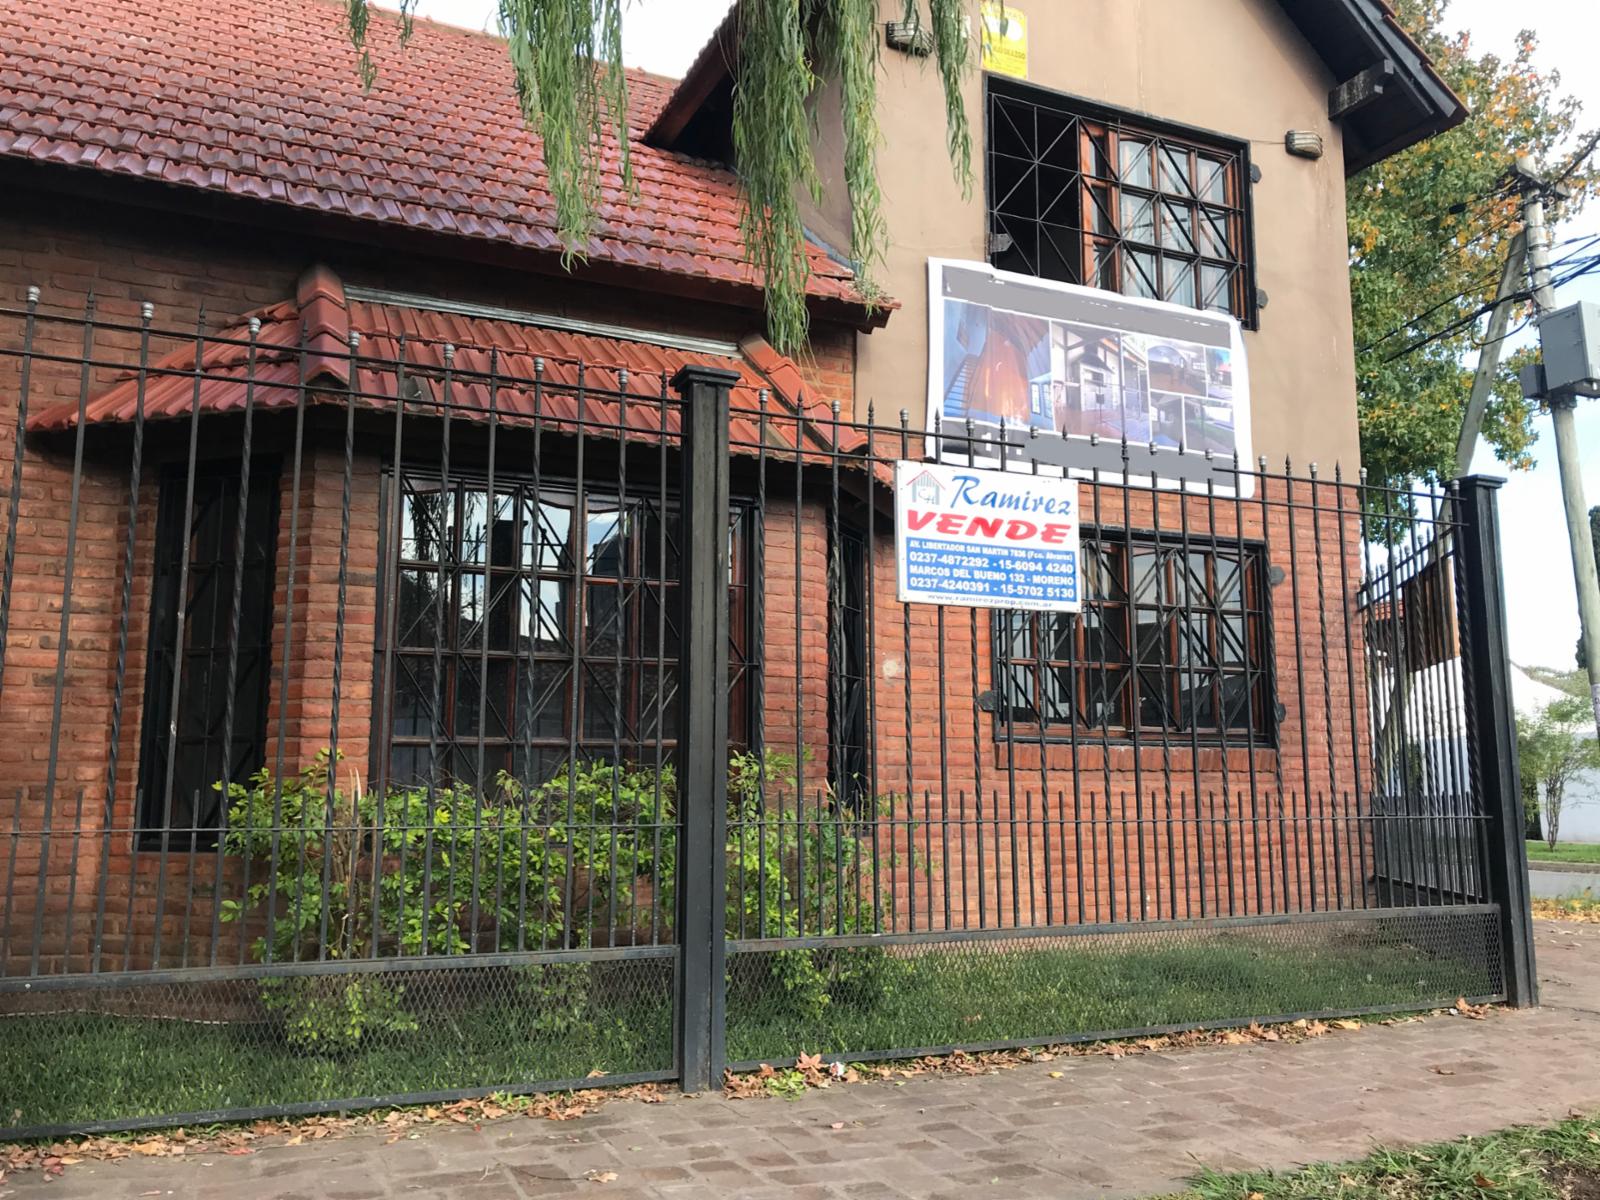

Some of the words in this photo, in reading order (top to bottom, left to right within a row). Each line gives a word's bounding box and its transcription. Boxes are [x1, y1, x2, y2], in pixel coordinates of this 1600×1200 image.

[950, 475, 1071, 516] Ramirez
[907, 509, 1072, 544] VENDE
[922, 541, 965, 552] LIBERTADOR
[967, 545, 981, 553] SAN
[982, 546, 1009, 556] MARTIN
[909, 551, 990, 568] 0237-4872292
[999, 560, 1043, 572] 15-6094
[1046, 563, 1074, 573] 4240
[909, 564, 950, 577] MARCOS
[953, 568, 971, 578] DEL
[973, 570, 1006, 581] BUENO
[1009, 573, 1025, 583] 132
[1032, 575, 1074, 585] MORENO
[909, 577, 990, 592] 0237-4240391
[1001, 584, 1043, 596] 15-5702
[1047, 587, 1074, 598] 5130
